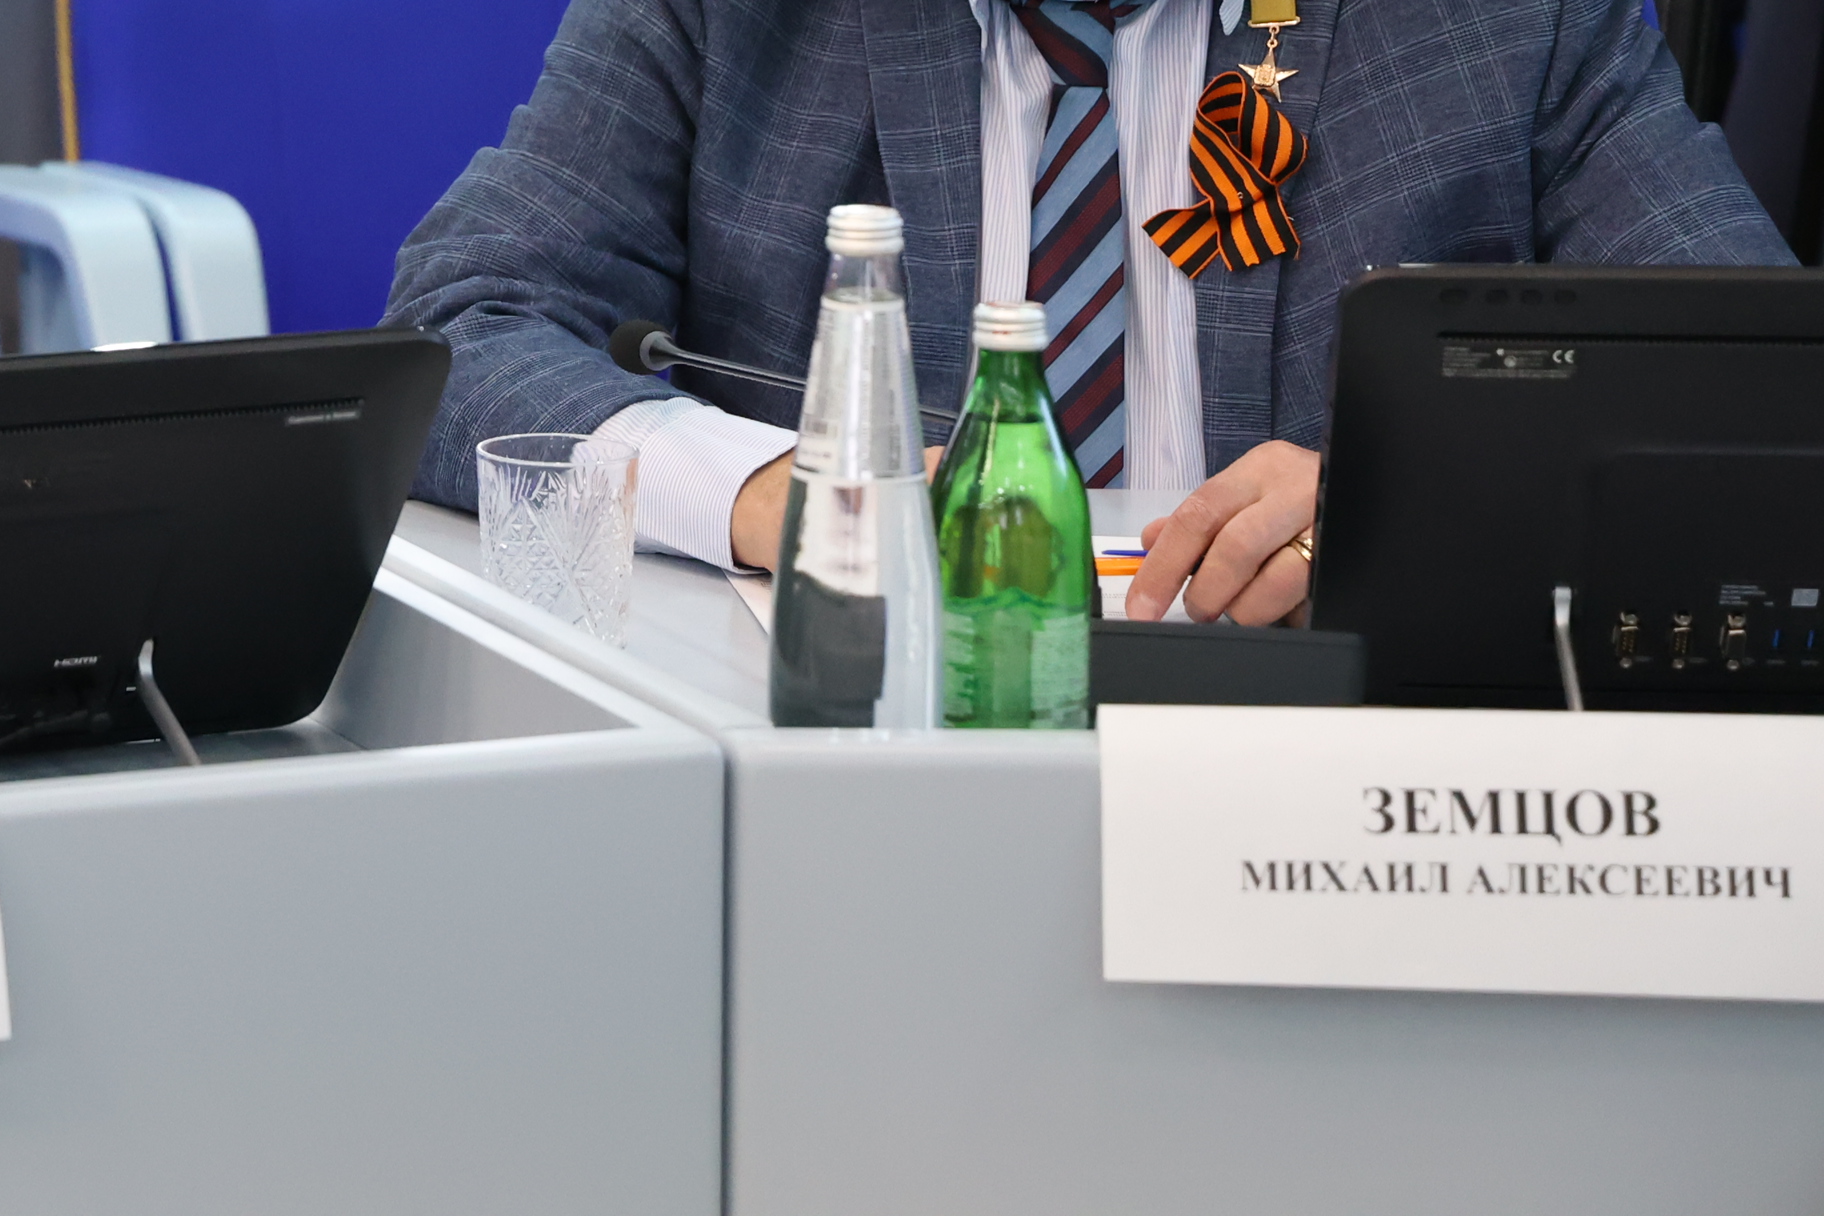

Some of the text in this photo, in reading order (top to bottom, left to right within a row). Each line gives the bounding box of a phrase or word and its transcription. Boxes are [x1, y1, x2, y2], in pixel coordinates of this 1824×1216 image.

[1362, 787, 1661, 845] ЗЕМЦОВ
[1241, 860, 1793, 899] МИХАИЛ АЛЕКСЕЕВИЧ
